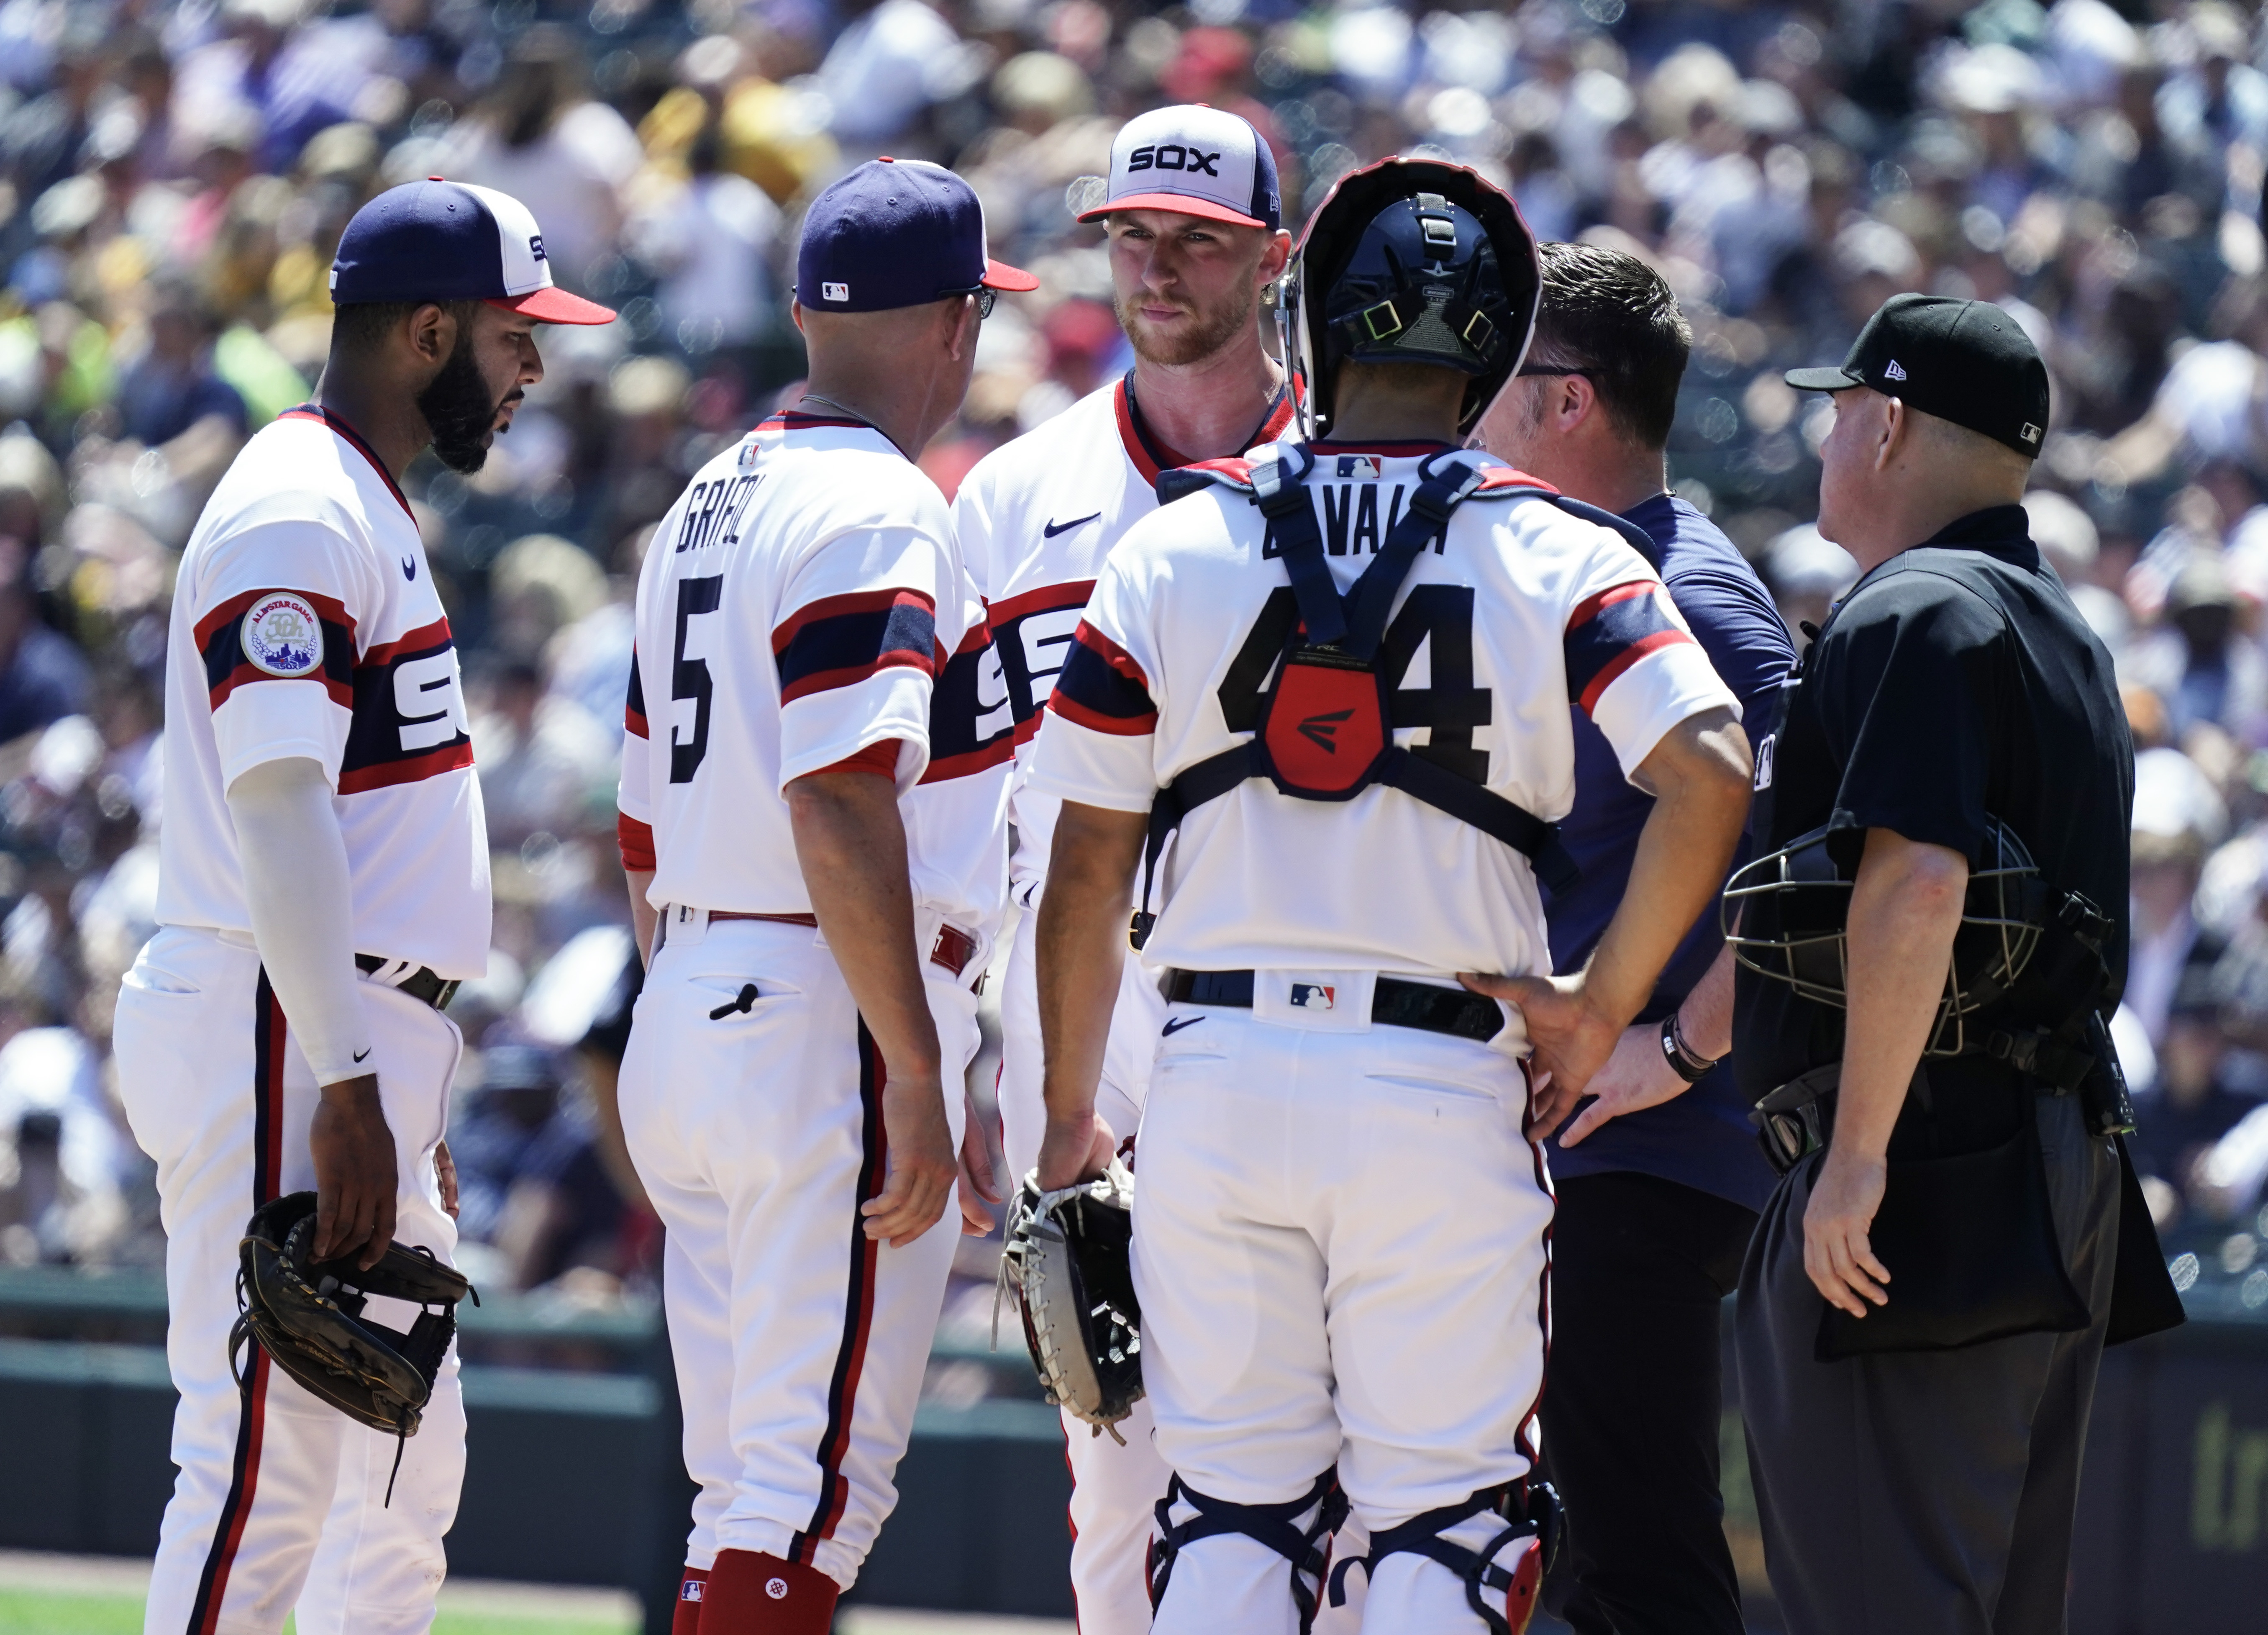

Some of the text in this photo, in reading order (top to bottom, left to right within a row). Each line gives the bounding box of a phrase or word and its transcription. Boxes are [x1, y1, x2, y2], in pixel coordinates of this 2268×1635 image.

[1128, 144, 1220, 177] SOX
[529, 235, 547, 262] S
[267, 601, 291, 611] STAR
[291, 603, 313, 624] GAME
[670, 574, 724, 784] 5
